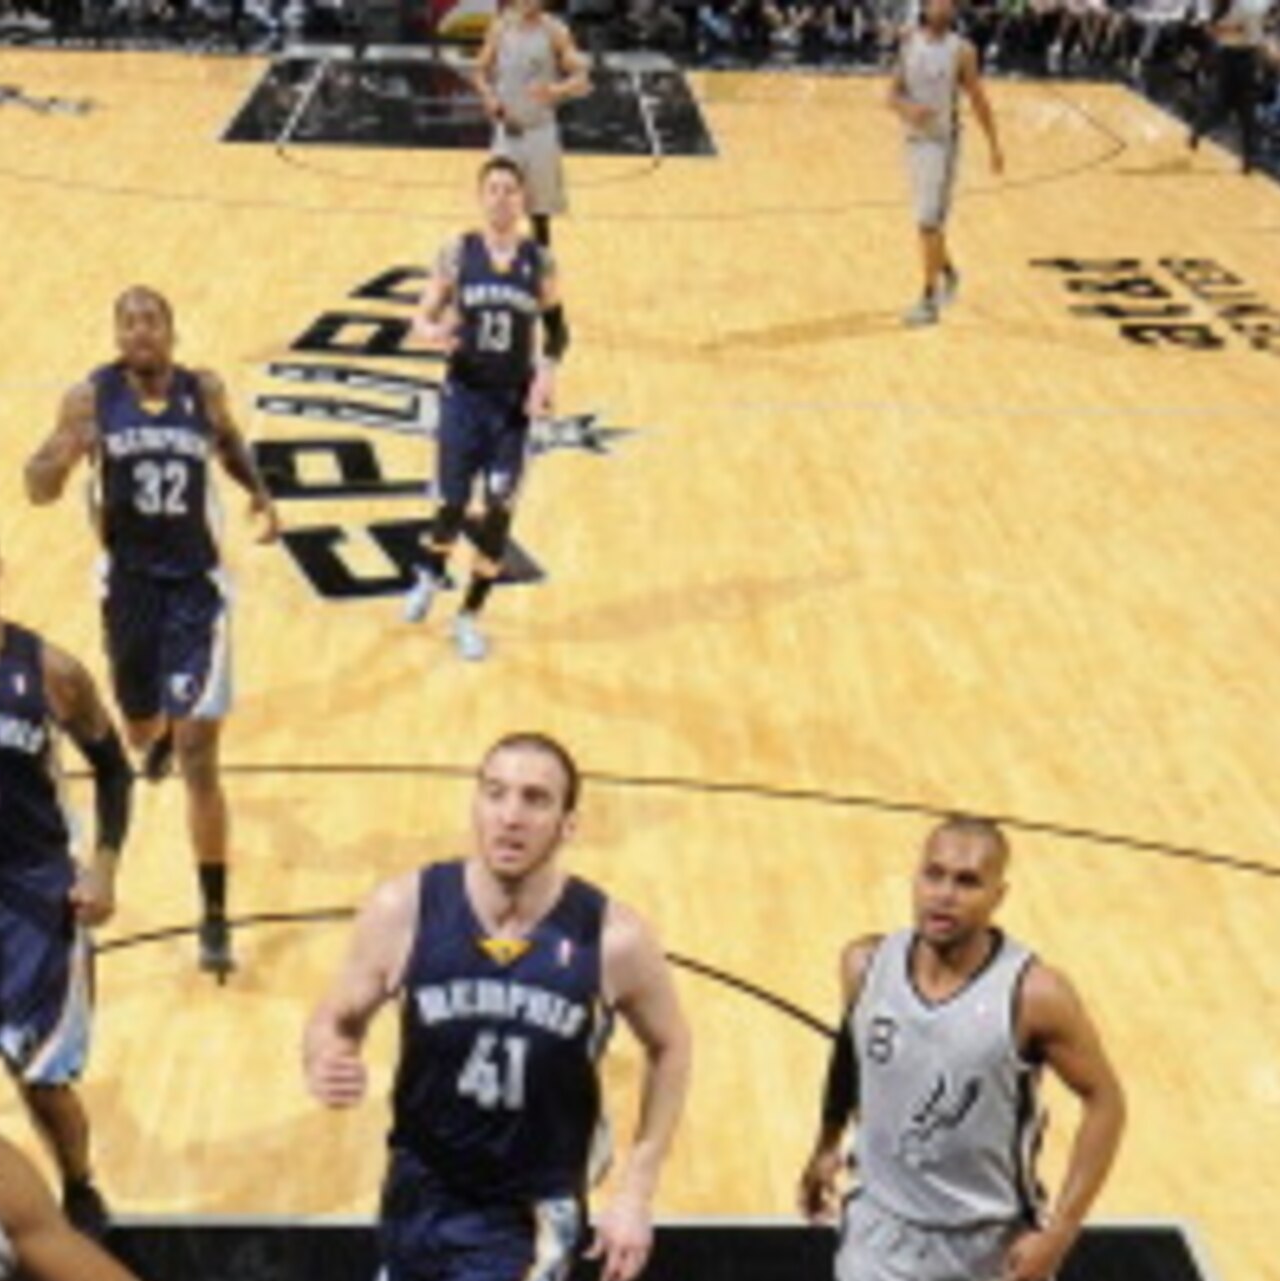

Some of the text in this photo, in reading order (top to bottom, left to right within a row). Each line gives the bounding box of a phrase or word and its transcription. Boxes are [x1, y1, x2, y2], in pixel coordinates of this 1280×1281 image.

[478, 310, 513, 352] 13
[132, 460, 189, 516] 32
[417, 978, 587, 1038] MEMPHIS
[867, 1015, 897, 1065] 8
[457, 1031, 528, 1109] 41
